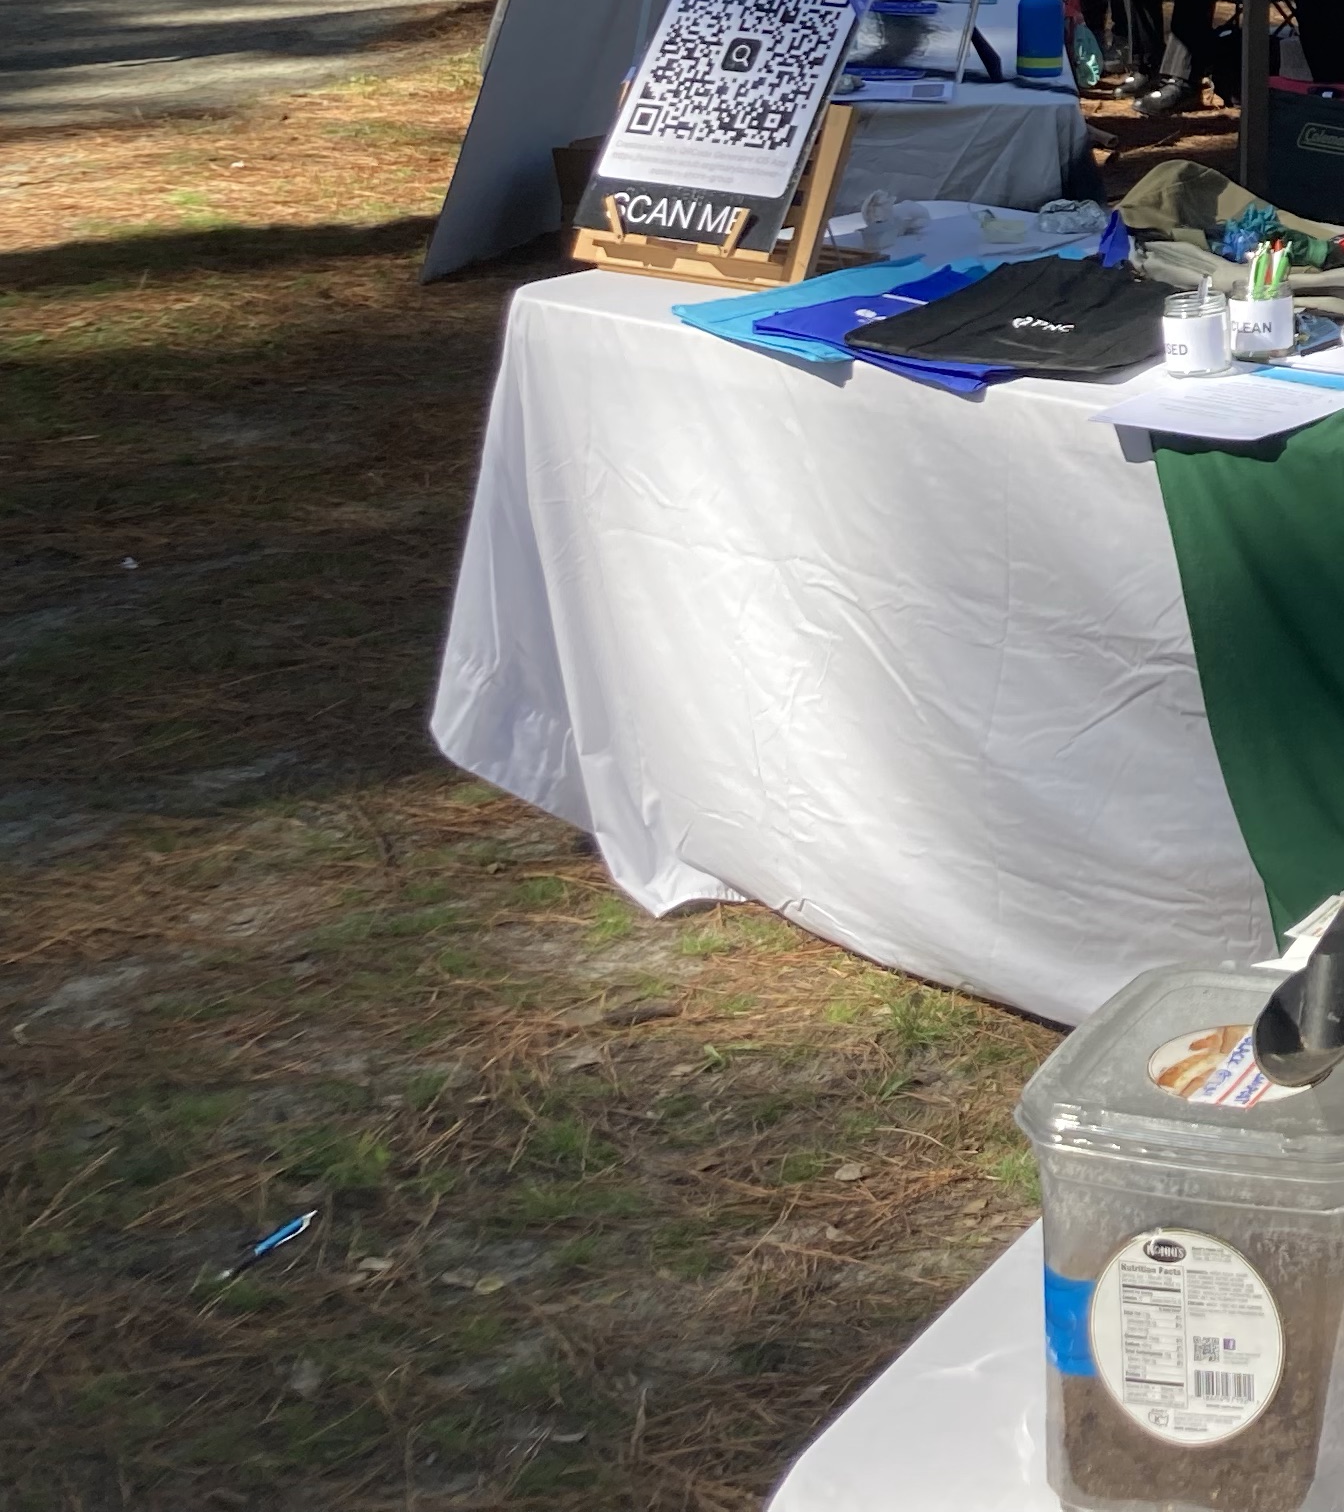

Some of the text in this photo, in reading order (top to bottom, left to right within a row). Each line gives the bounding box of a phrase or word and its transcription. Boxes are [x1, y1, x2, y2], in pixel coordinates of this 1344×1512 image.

[607, 192, 697, 230] SCAN
[1031, 317, 1076, 334] PNC
[1230, 319, 1273, 335] CLEAN
[1165, 343, 1189, 356] SED
[1121, 1263, 1182, 1276] Nutrition Facts
